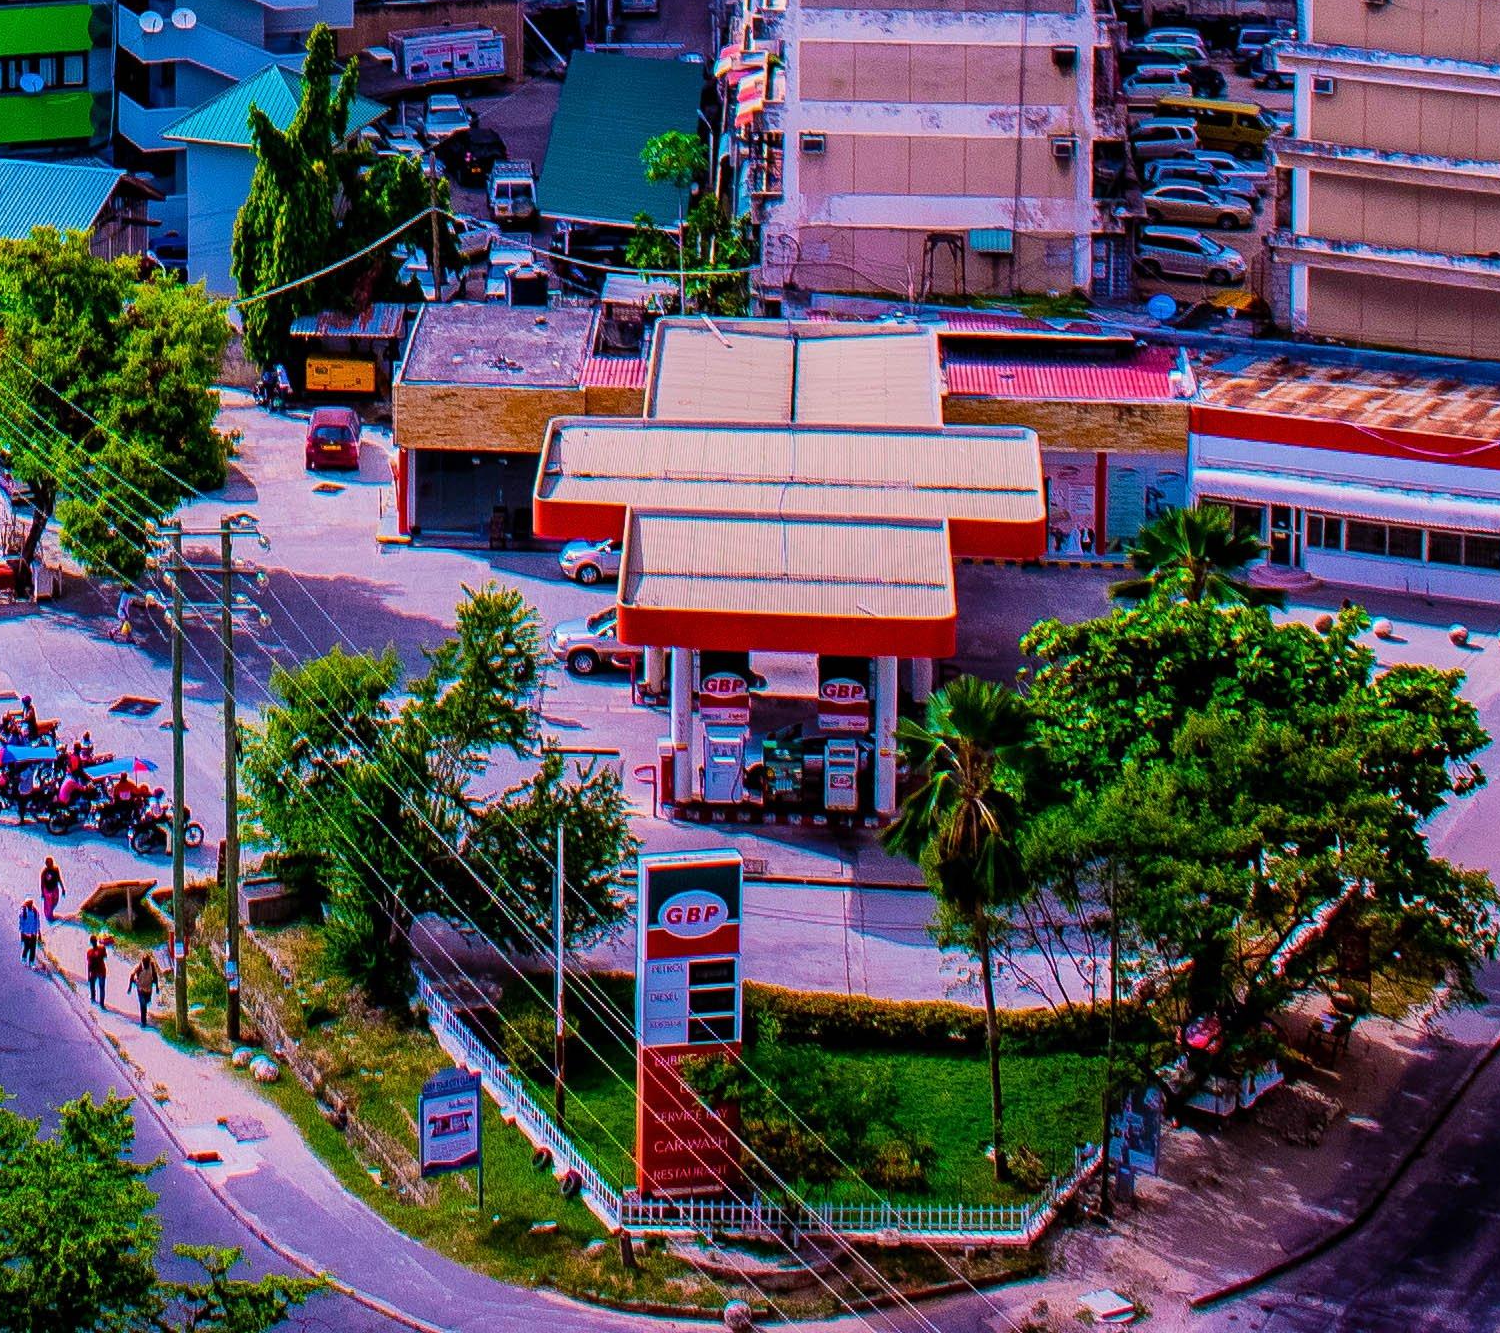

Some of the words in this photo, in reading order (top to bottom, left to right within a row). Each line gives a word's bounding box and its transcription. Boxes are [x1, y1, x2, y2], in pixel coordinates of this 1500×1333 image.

[703, 678, 745, 693] GBP
[822, 683, 866, 699] GBP
[665, 905, 720, 924] GBP
[650, 991, 679, 1002] DIESEL
[654, 1140, 684, 1153] CAR
[687, 1136, 728, 1150] WASH
